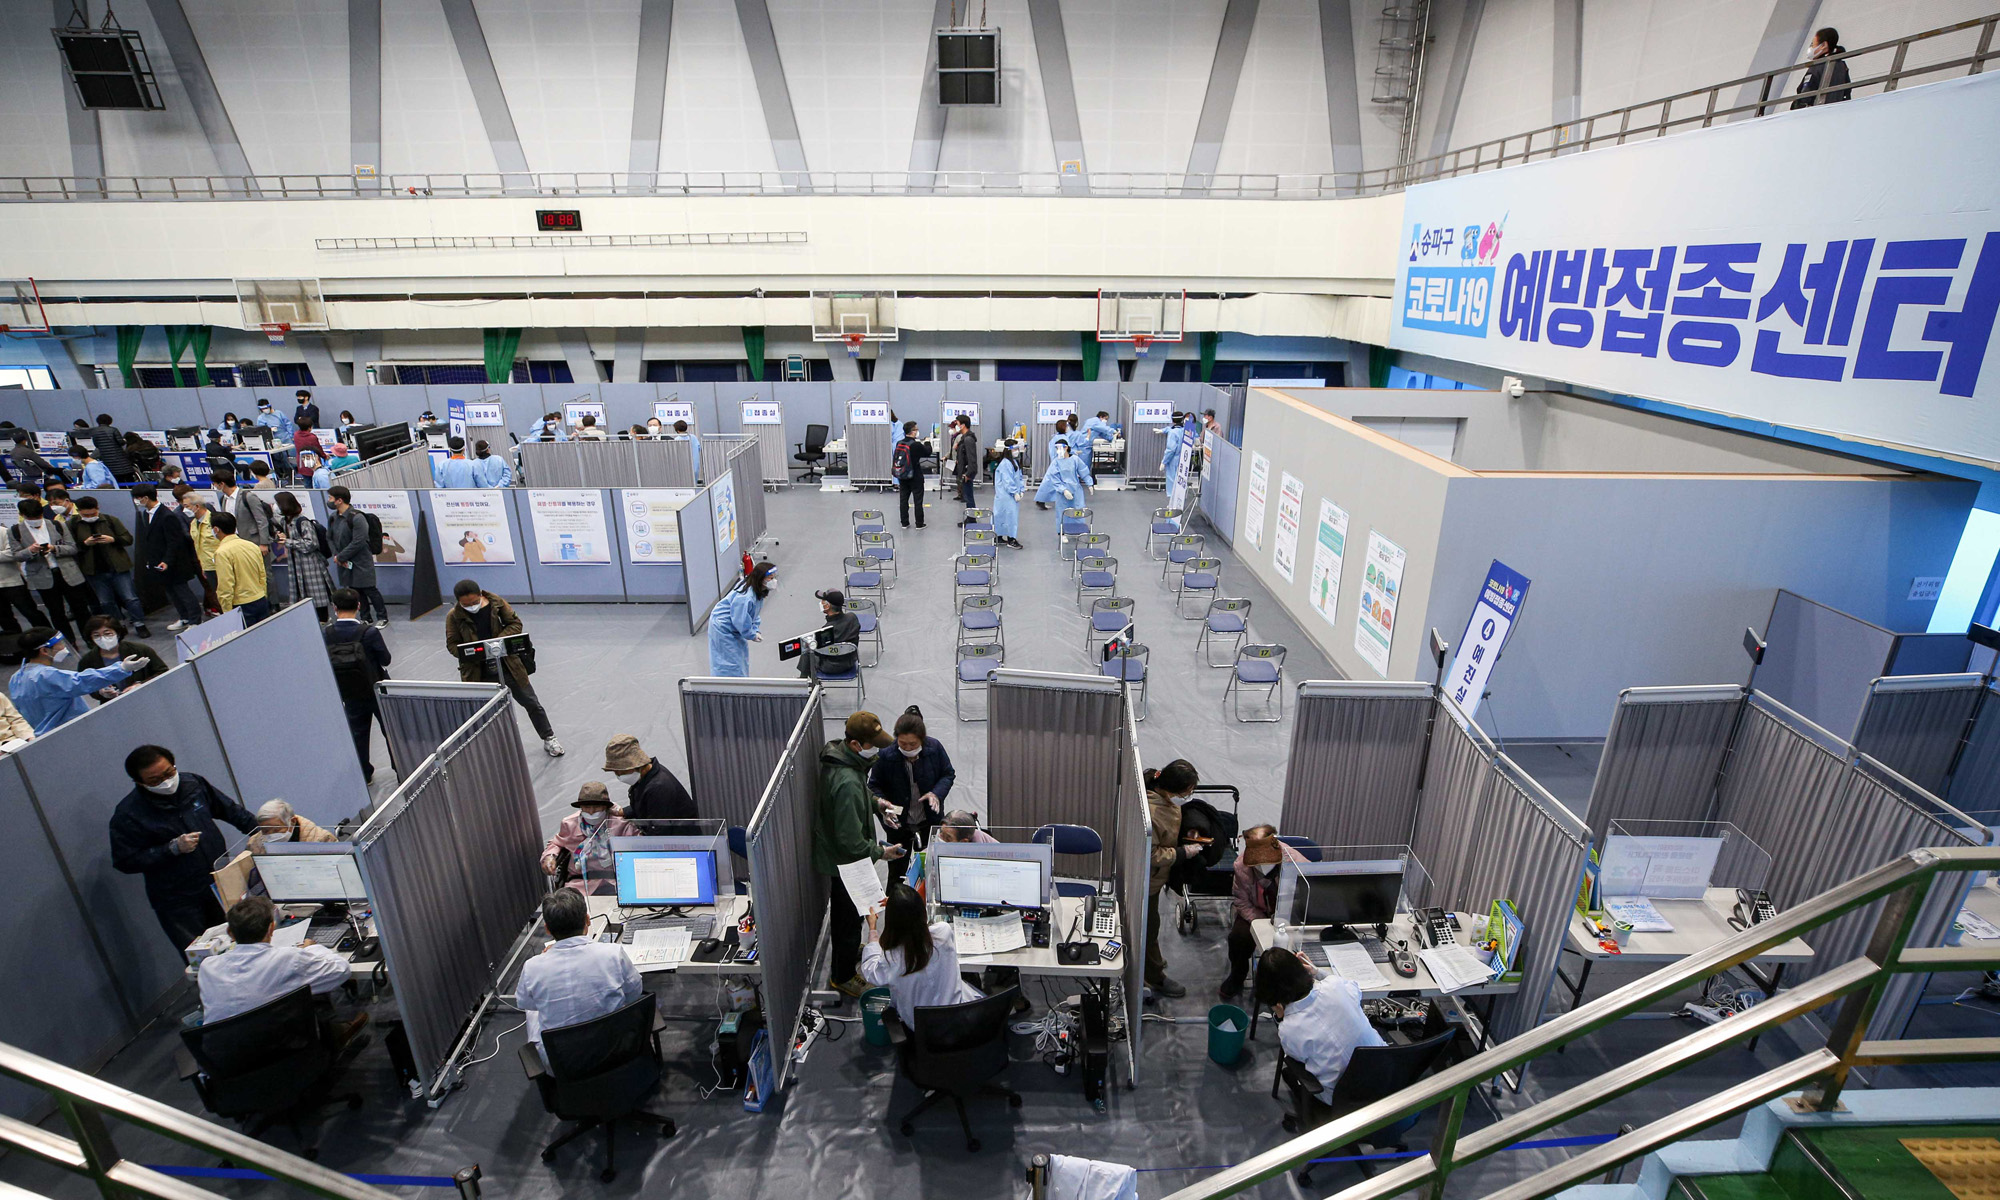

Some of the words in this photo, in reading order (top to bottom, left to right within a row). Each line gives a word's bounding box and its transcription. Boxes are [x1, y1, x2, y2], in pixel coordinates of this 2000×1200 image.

[1422, 228, 1454, 256] 송파구
[1406, 276, 1488, 328] 코로나19
[1498, 231, 2000, 398] 예방접종센터
[1484, 589, 1516, 616] 예방접종센터
[1484, 621, 1493, 638] 4
[1455, 644, 1485, 705] 예진실
